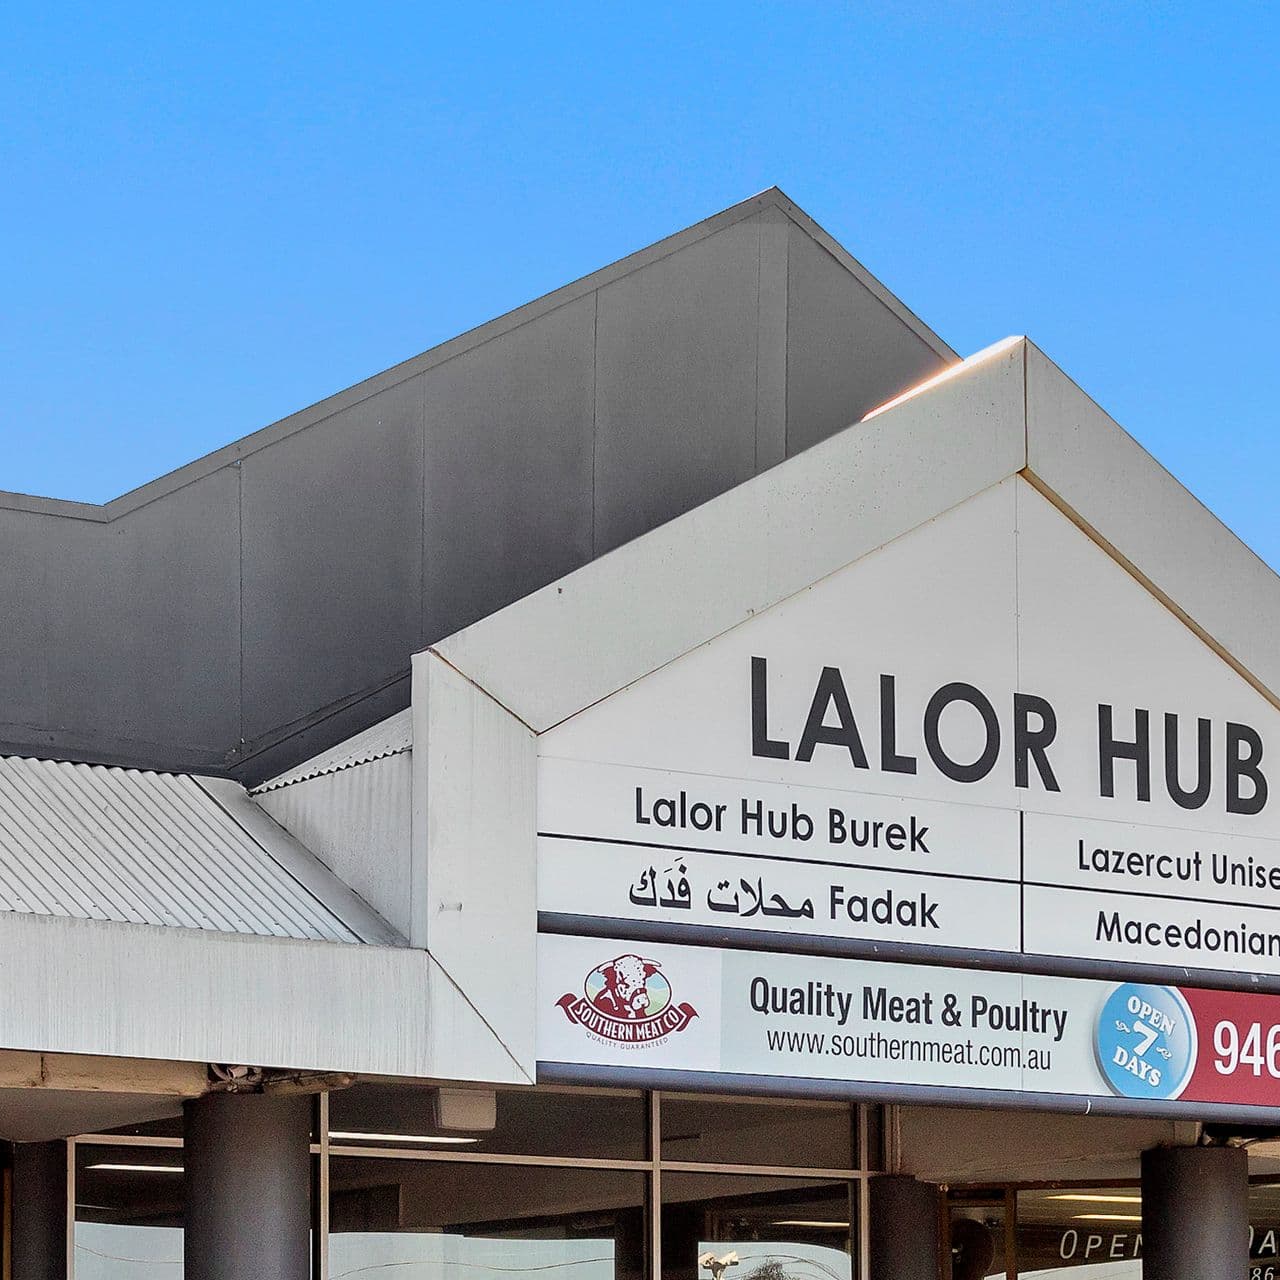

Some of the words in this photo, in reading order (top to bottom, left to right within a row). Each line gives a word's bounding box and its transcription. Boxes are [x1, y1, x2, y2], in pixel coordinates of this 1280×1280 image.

[751, 656, 1061, 792] LALOR
[1097, 703, 1270, 818] HUB
[635, 787, 725, 832] Lalor
[741, 798, 813, 841] Hub
[828, 807, 929, 853] Burek
[1078, 839, 1202, 882] Lazercut
[707, 876, 814, 919] محلات
[830, 885, 940, 929] Fadak
[575, 1002, 633, 1041] SOUTHERN
[637, 1019, 661, 1040] MEAT
[664, 1009, 679, 1029] CO
[750, 976, 852, 1025] Quality
[863, 985, 933, 1026] Meat
[944, 993, 962, 1028] &
[971, 995, 1068, 1042] Poultry
[1127, 996, 1175, 1037] OPEN
[586, 1031, 617, 1048] QUALITY
[620, 1037, 669, 1050] GUARANTEED
[767, 1029, 1051, 1070] www.southernmeat.com.au
[1132, 1020, 1159, 1057] 7
[1112, 1046, 1162, 1088] DAYS
